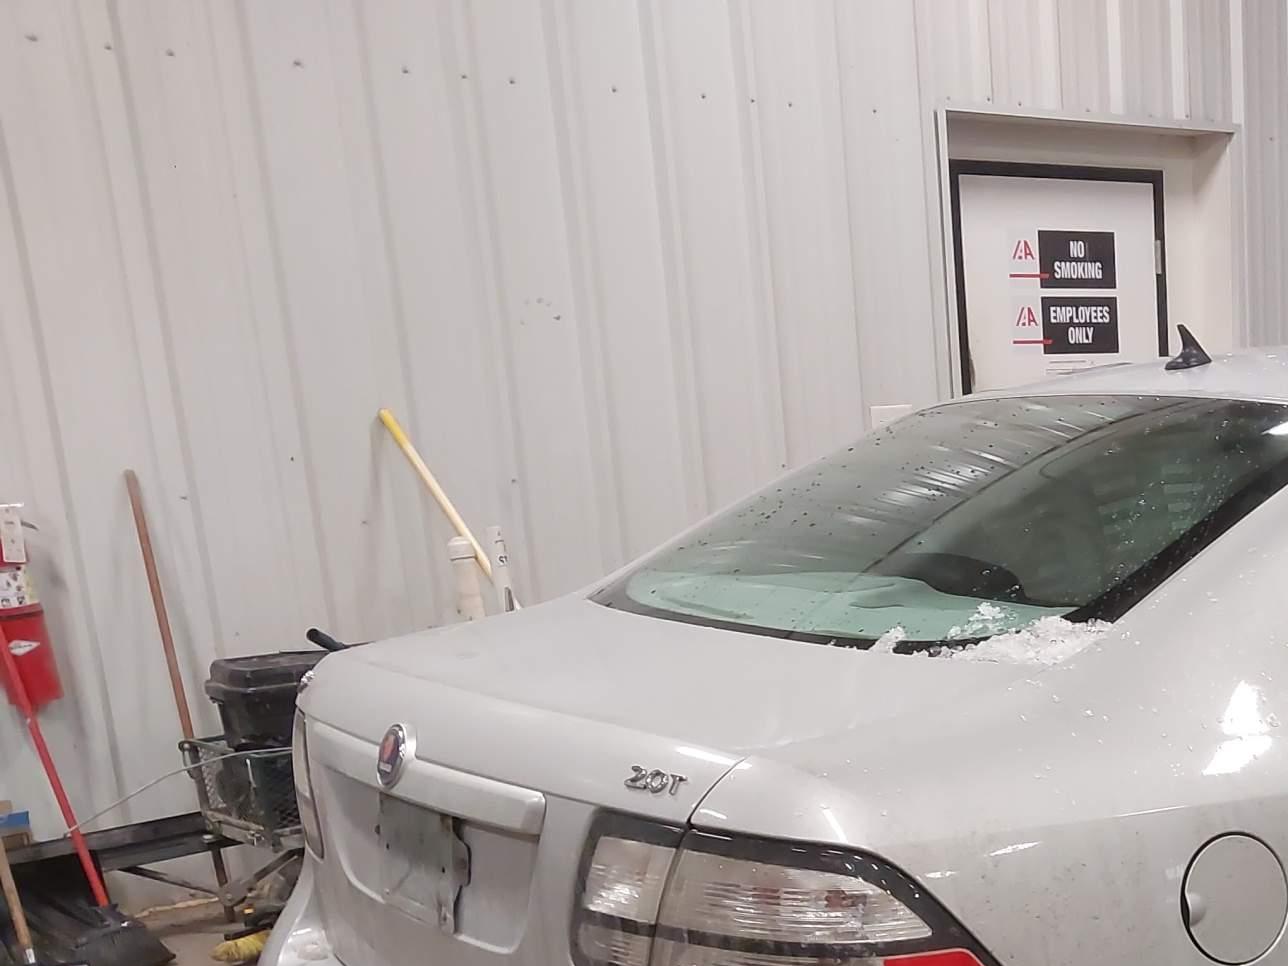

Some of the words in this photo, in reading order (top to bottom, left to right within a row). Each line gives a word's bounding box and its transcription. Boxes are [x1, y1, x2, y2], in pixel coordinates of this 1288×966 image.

[1069, 240, 1085, 258] NO
[1053, 261, 1103, 279] SMOKING
[1050, 306, 1110, 323] EMPLOYEES
[1067, 327, 1094, 344] ONLY
